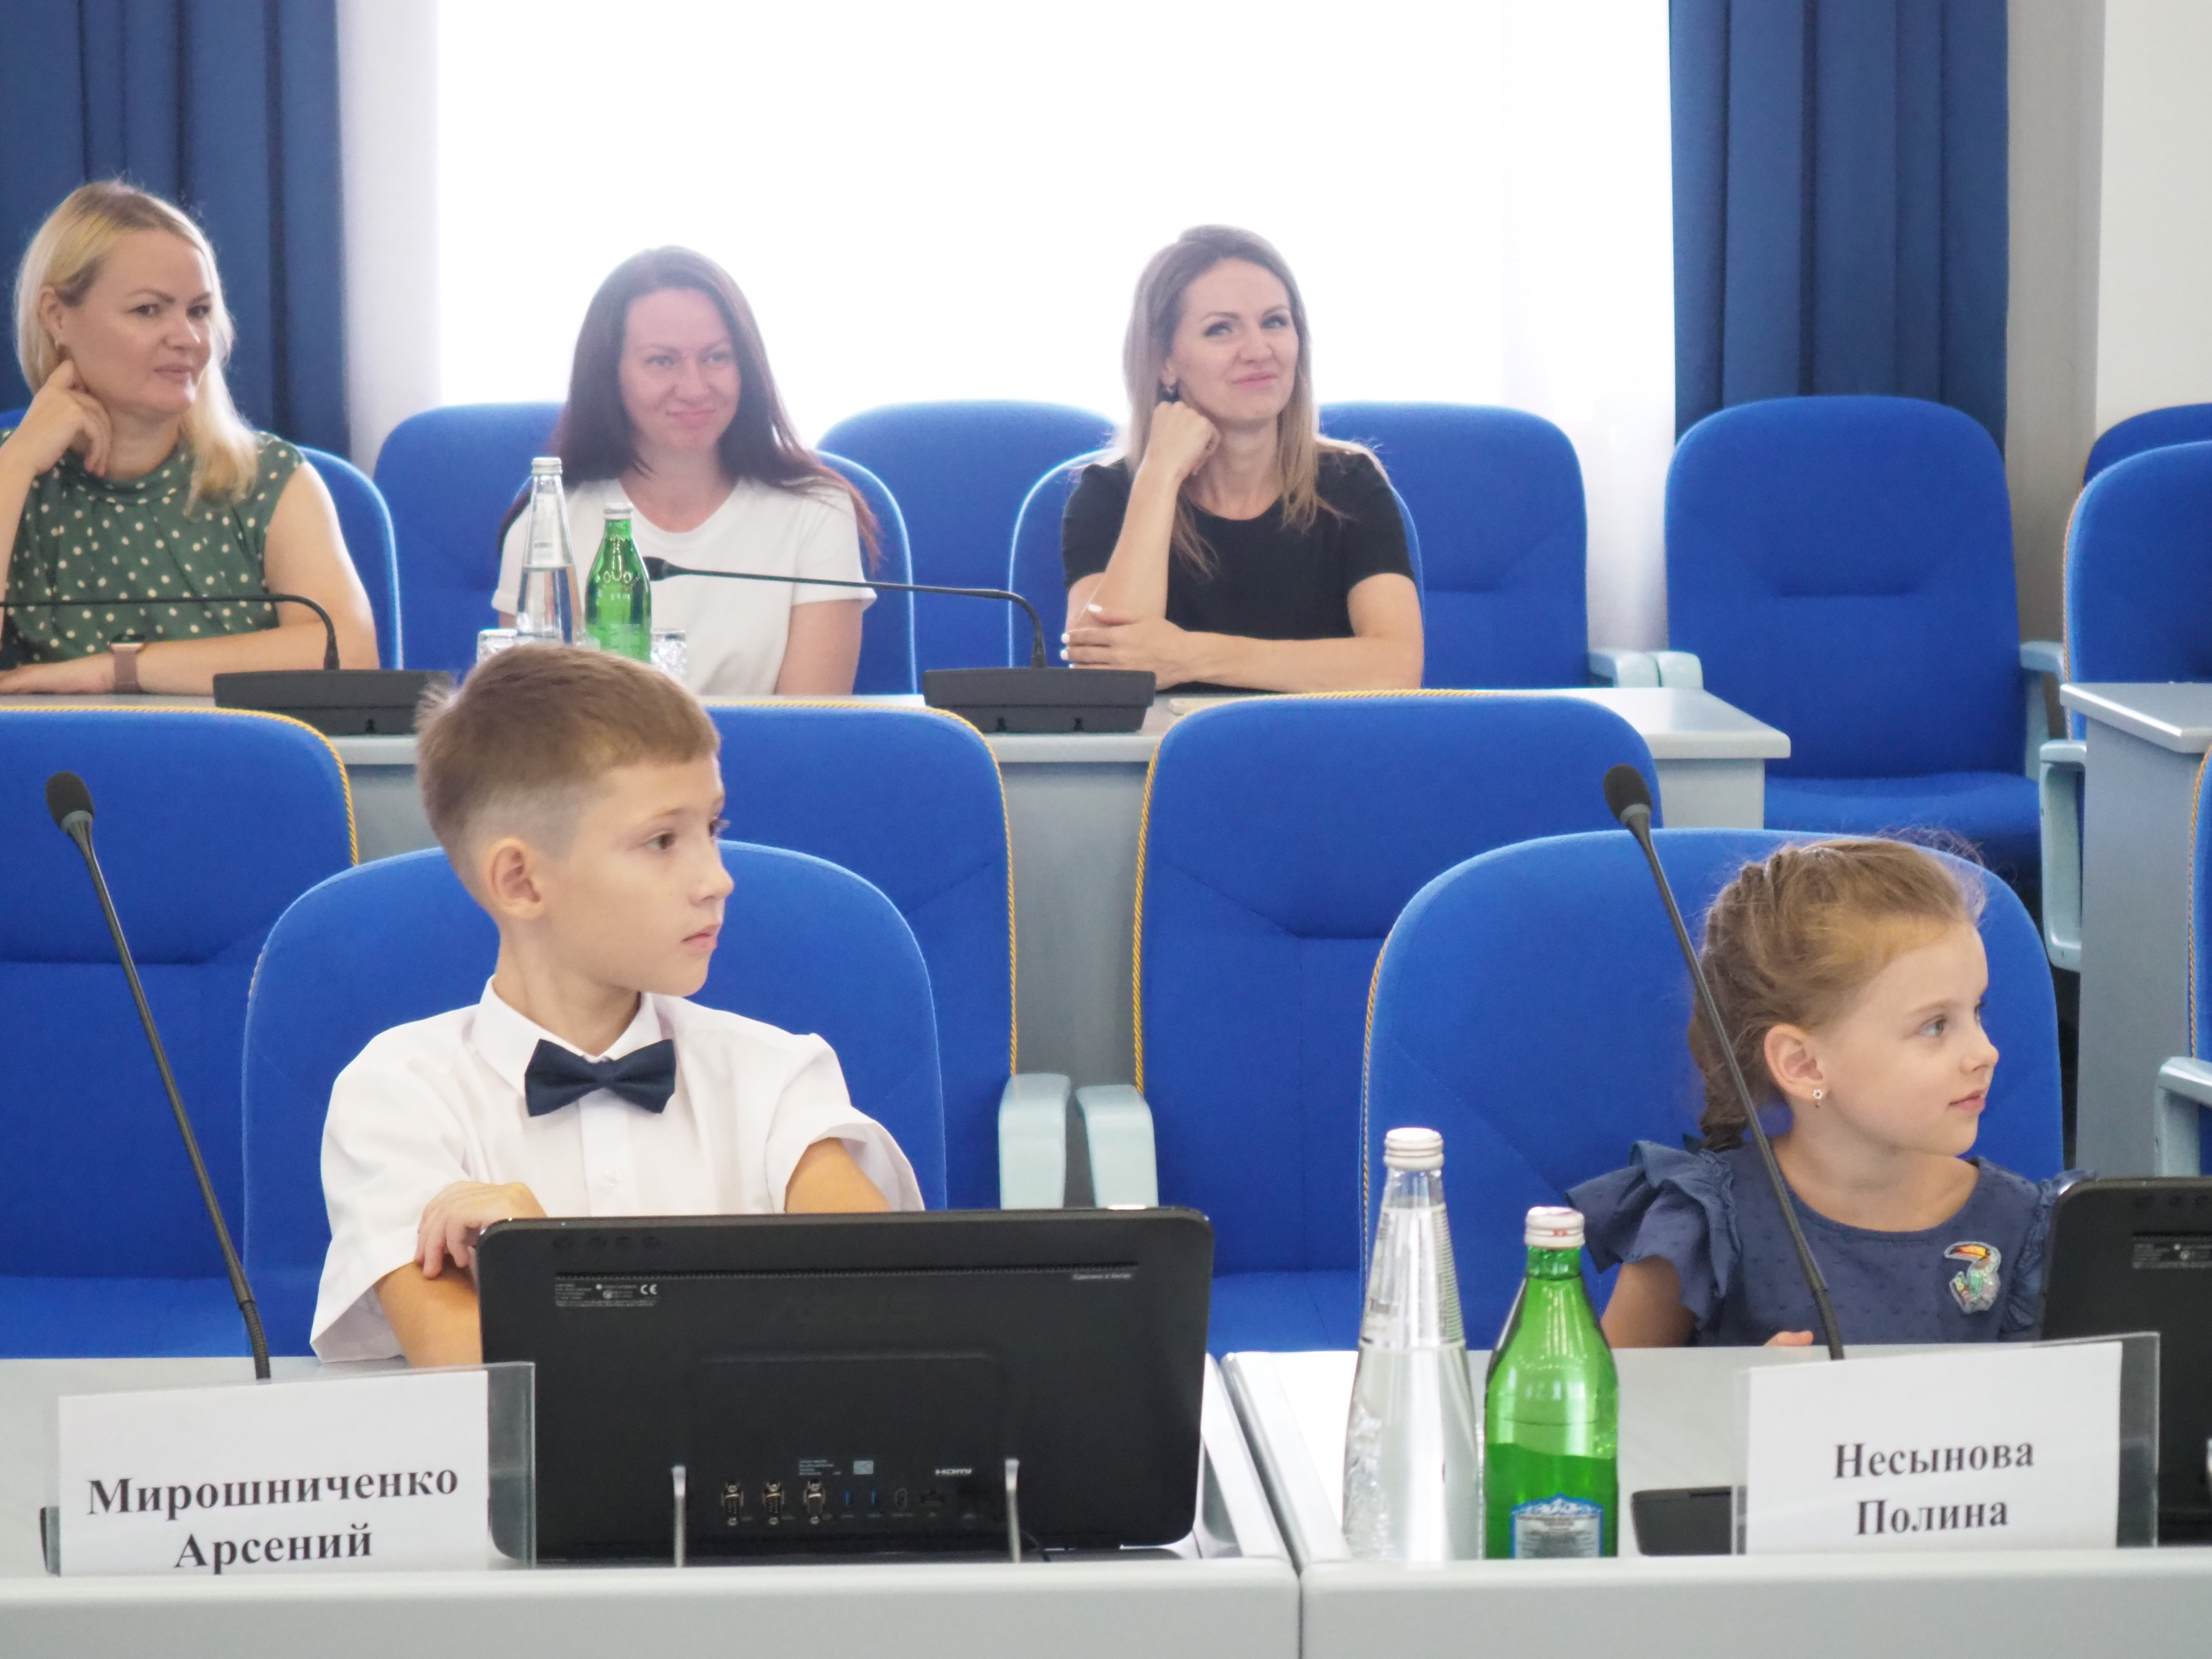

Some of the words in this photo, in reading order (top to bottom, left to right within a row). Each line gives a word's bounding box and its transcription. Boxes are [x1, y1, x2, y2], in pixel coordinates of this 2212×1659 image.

[1832, 1442, 2034, 1479] Несынова
[87, 1469, 458, 1521] Мирошниченко
[1855, 1500, 2008, 1536] Полина
[173, 1522, 372, 1575] Арсений
